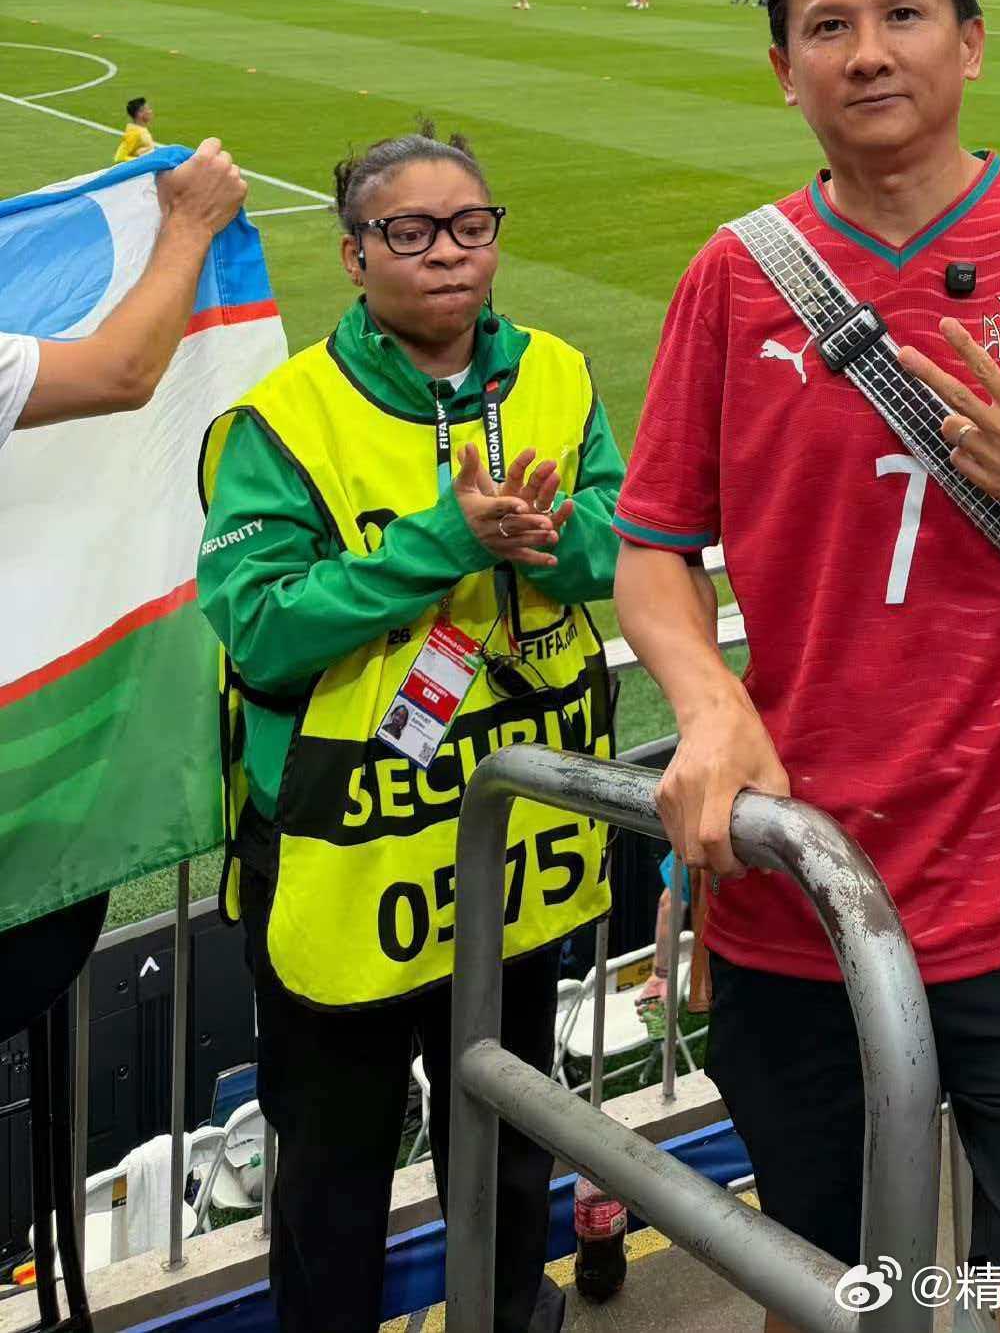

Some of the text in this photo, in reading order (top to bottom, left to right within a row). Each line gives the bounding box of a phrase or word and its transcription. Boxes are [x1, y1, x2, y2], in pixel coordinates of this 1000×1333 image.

[487, 403, 498, 431] FIFA
[438, 422, 449, 450] FIFA
[201, 519, 263, 556] SECURITY
[875, 453, 929, 604] 7
